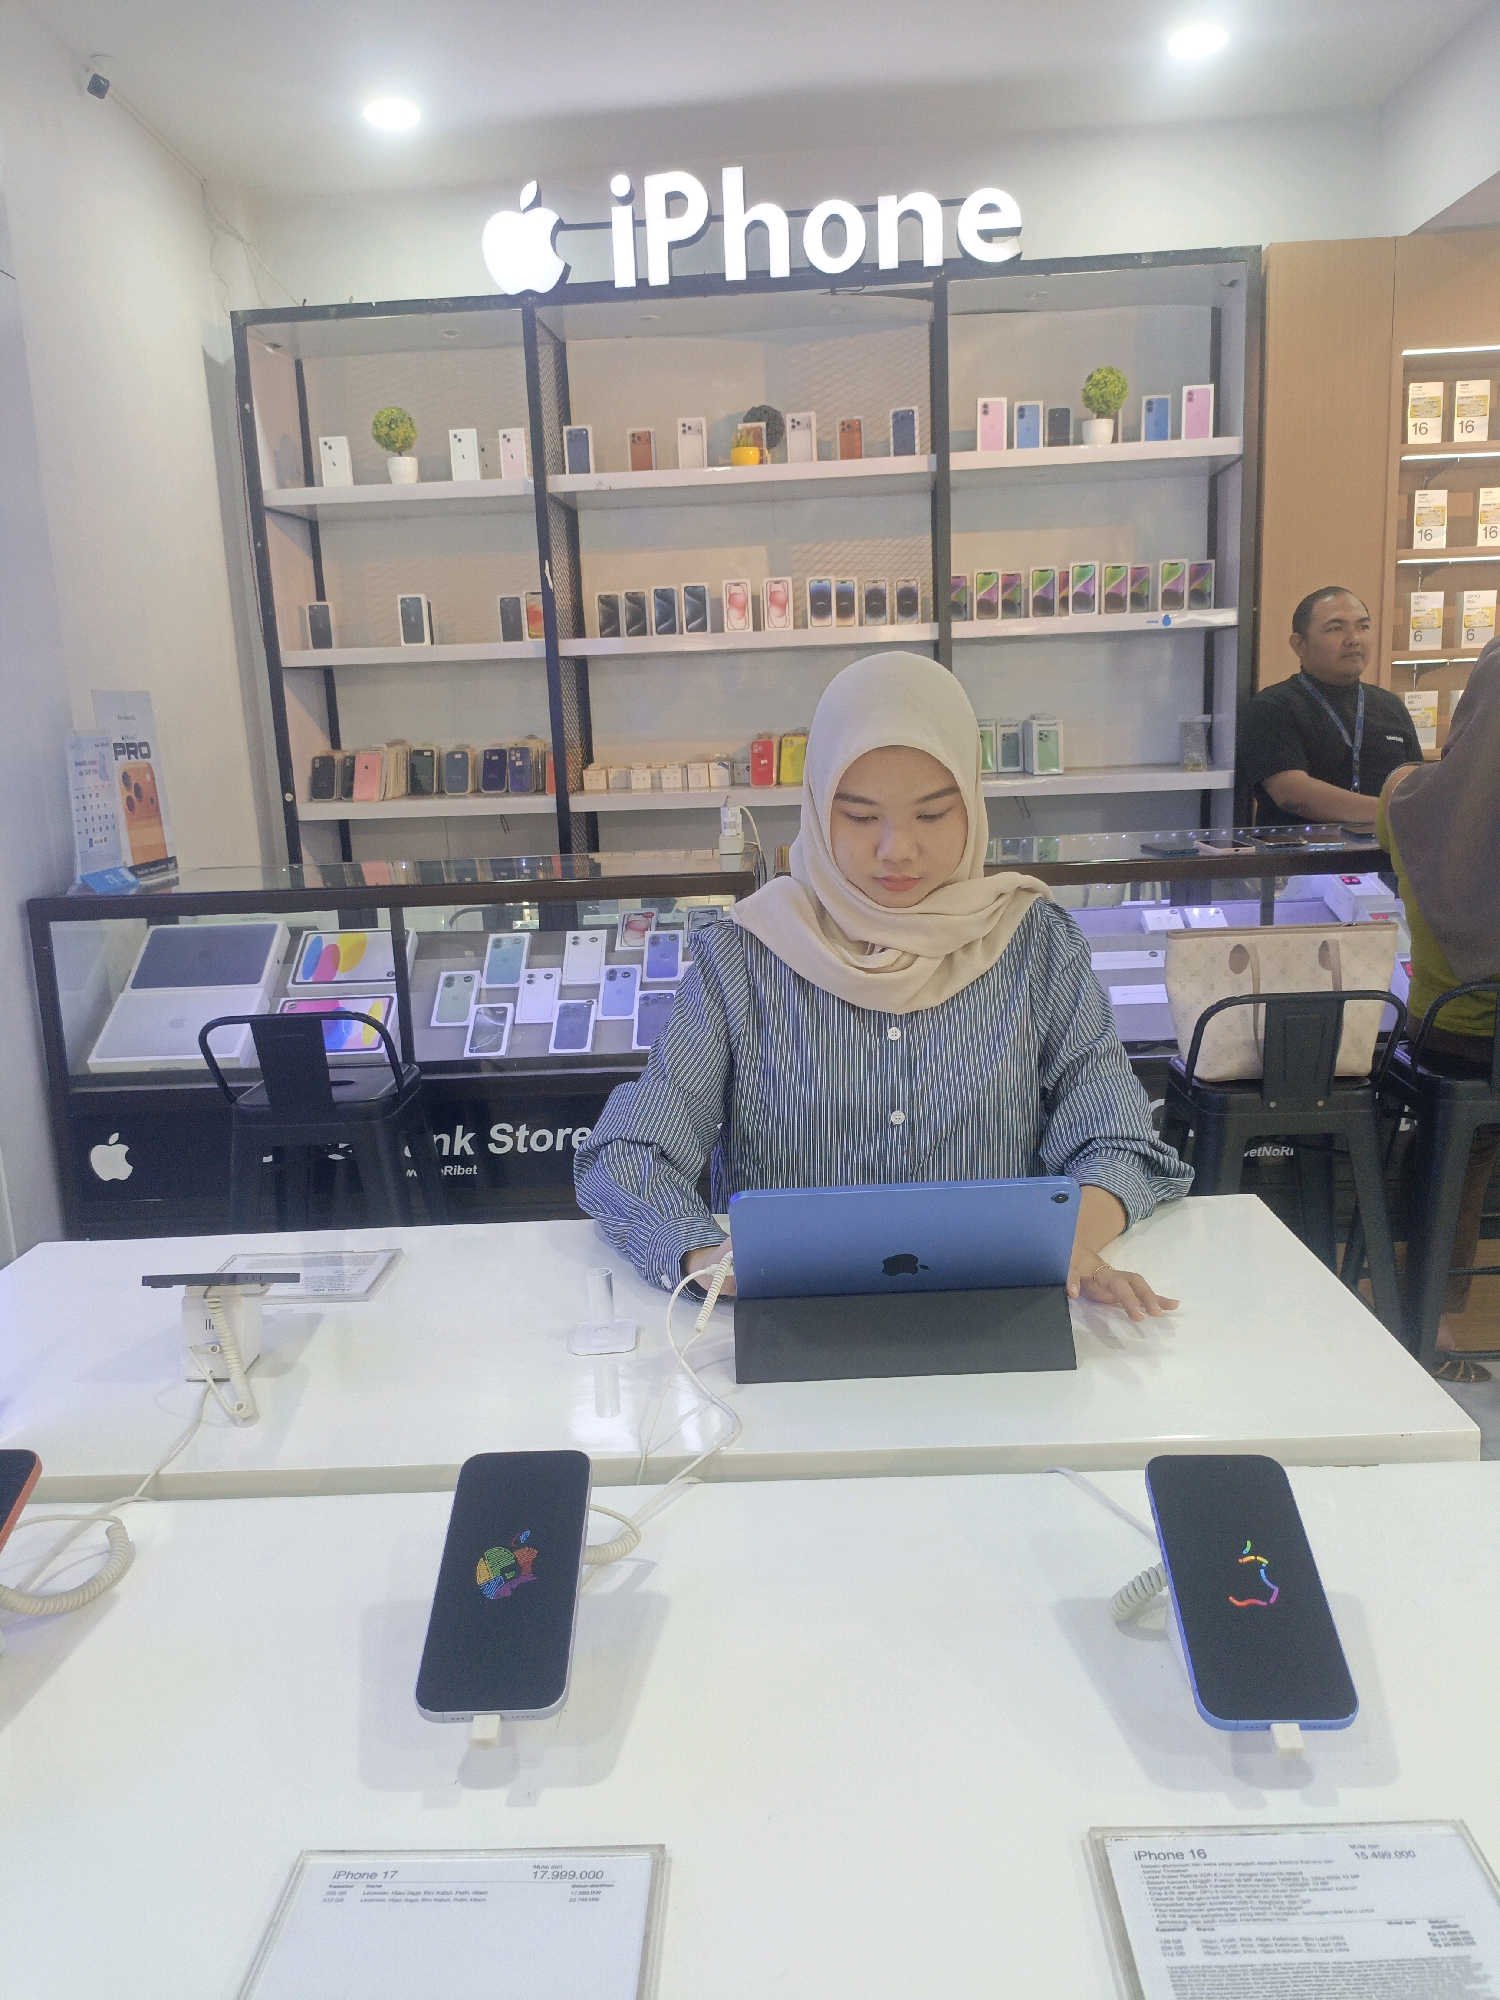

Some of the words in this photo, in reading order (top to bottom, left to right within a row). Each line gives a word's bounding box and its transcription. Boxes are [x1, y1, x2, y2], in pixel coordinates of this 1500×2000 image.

[610, 166, 1022, 288] iPhone
[1412, 421, 1429, 436] 16
[1458, 419, 1475, 434] 16
[1417, 528, 1433, 542] 16
[1482, 525, 1498, 540] 16
[1413, 629, 1423, 643] 6
[1466, 628, 1475, 642] 6
[112, 741, 152, 761] PRO
[1133, 1850, 1185, 1861] iPhone
[1189, 1848, 1208, 1860] 16
[332, 1870, 378, 1880] iPhone
[382, 1870, 399, 1880] 17
[532, 1870, 604, 1880] 17.999.000
